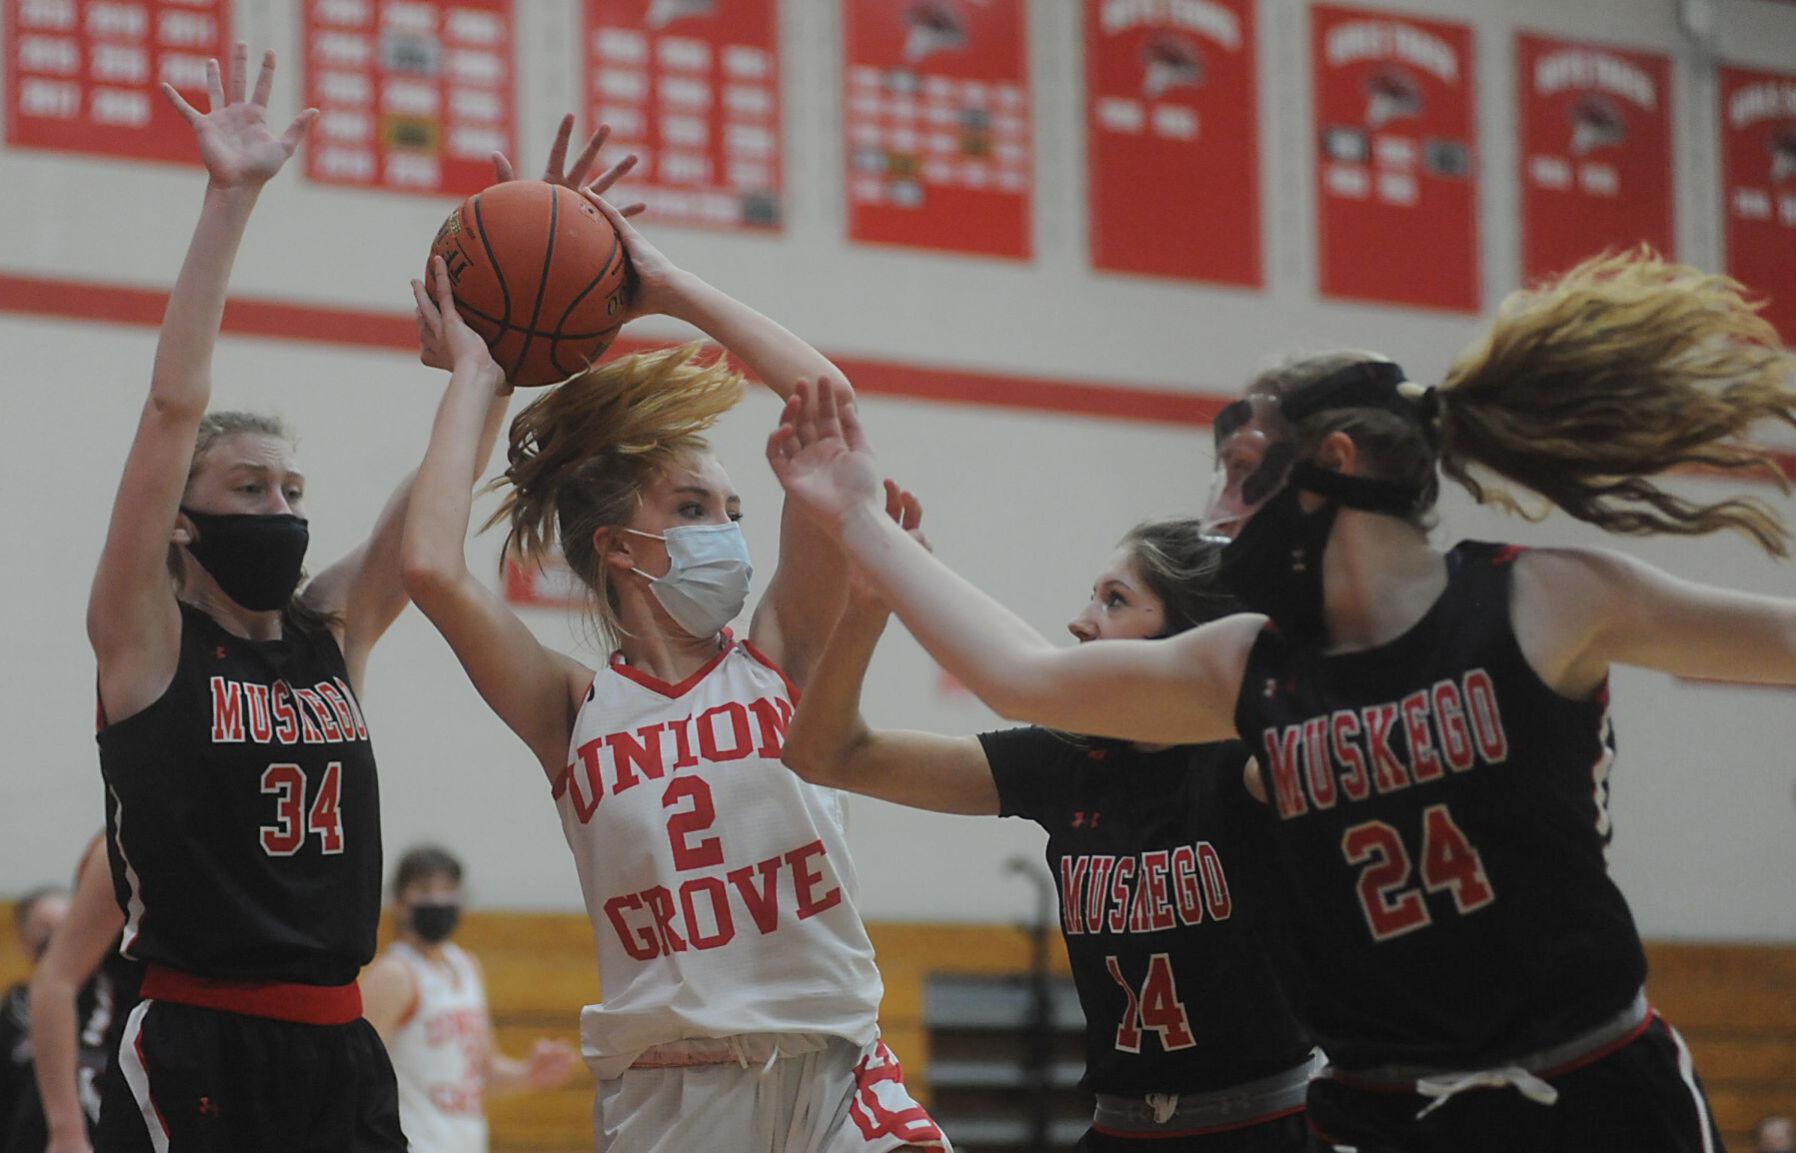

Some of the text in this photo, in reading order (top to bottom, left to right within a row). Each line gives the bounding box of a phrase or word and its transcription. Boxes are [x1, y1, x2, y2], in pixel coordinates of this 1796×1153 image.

[553, 696, 796, 825] UNION
[1264, 667, 1508, 821] MUSKEGO
[259, 761, 344, 856] 34
[661, 774, 725, 872] 2
[603, 839, 842, 962] GROVE
[1341, 803, 1496, 942] 24
[1104, 952, 1198, 1055] 14
